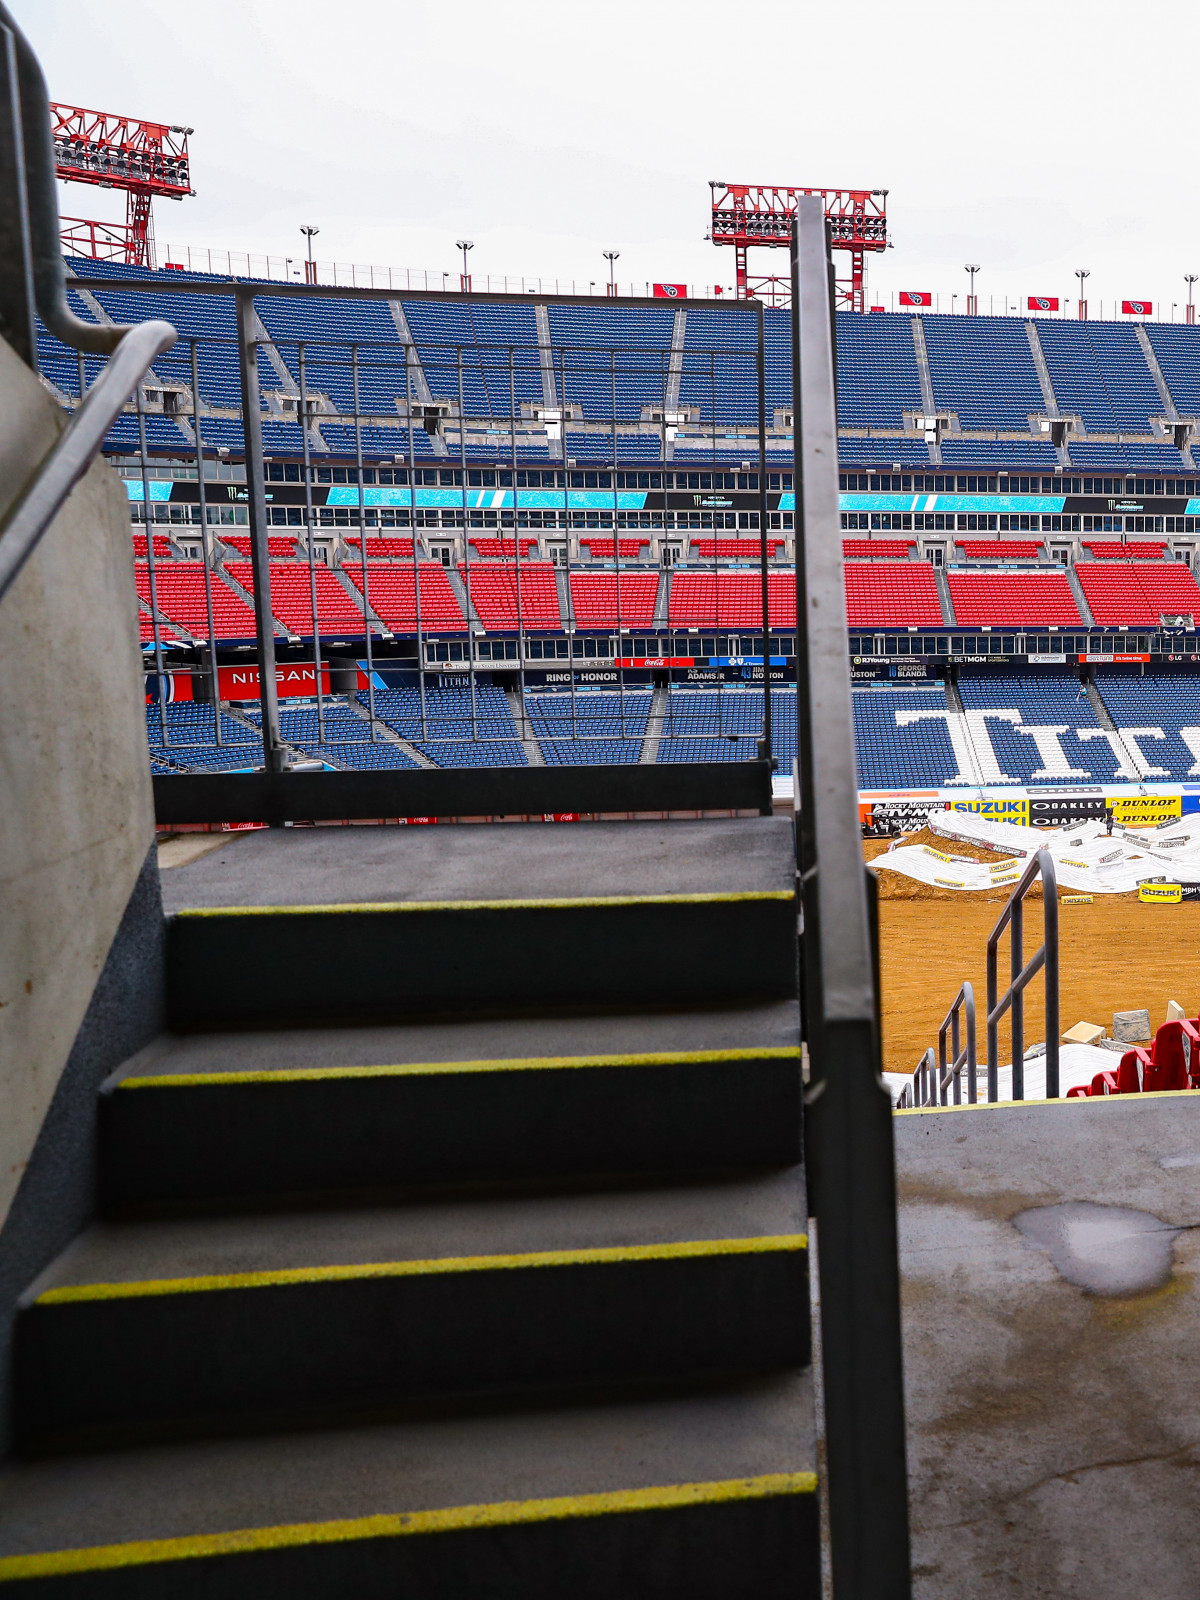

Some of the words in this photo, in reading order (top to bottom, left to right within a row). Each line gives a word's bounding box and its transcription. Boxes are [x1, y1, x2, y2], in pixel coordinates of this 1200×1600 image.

[546, 674, 571, 682] RING
[581, 673, 618, 681] HONOR
[741, 667, 751, 679] 43
[954, 801, 1026, 814] SUZUKI
